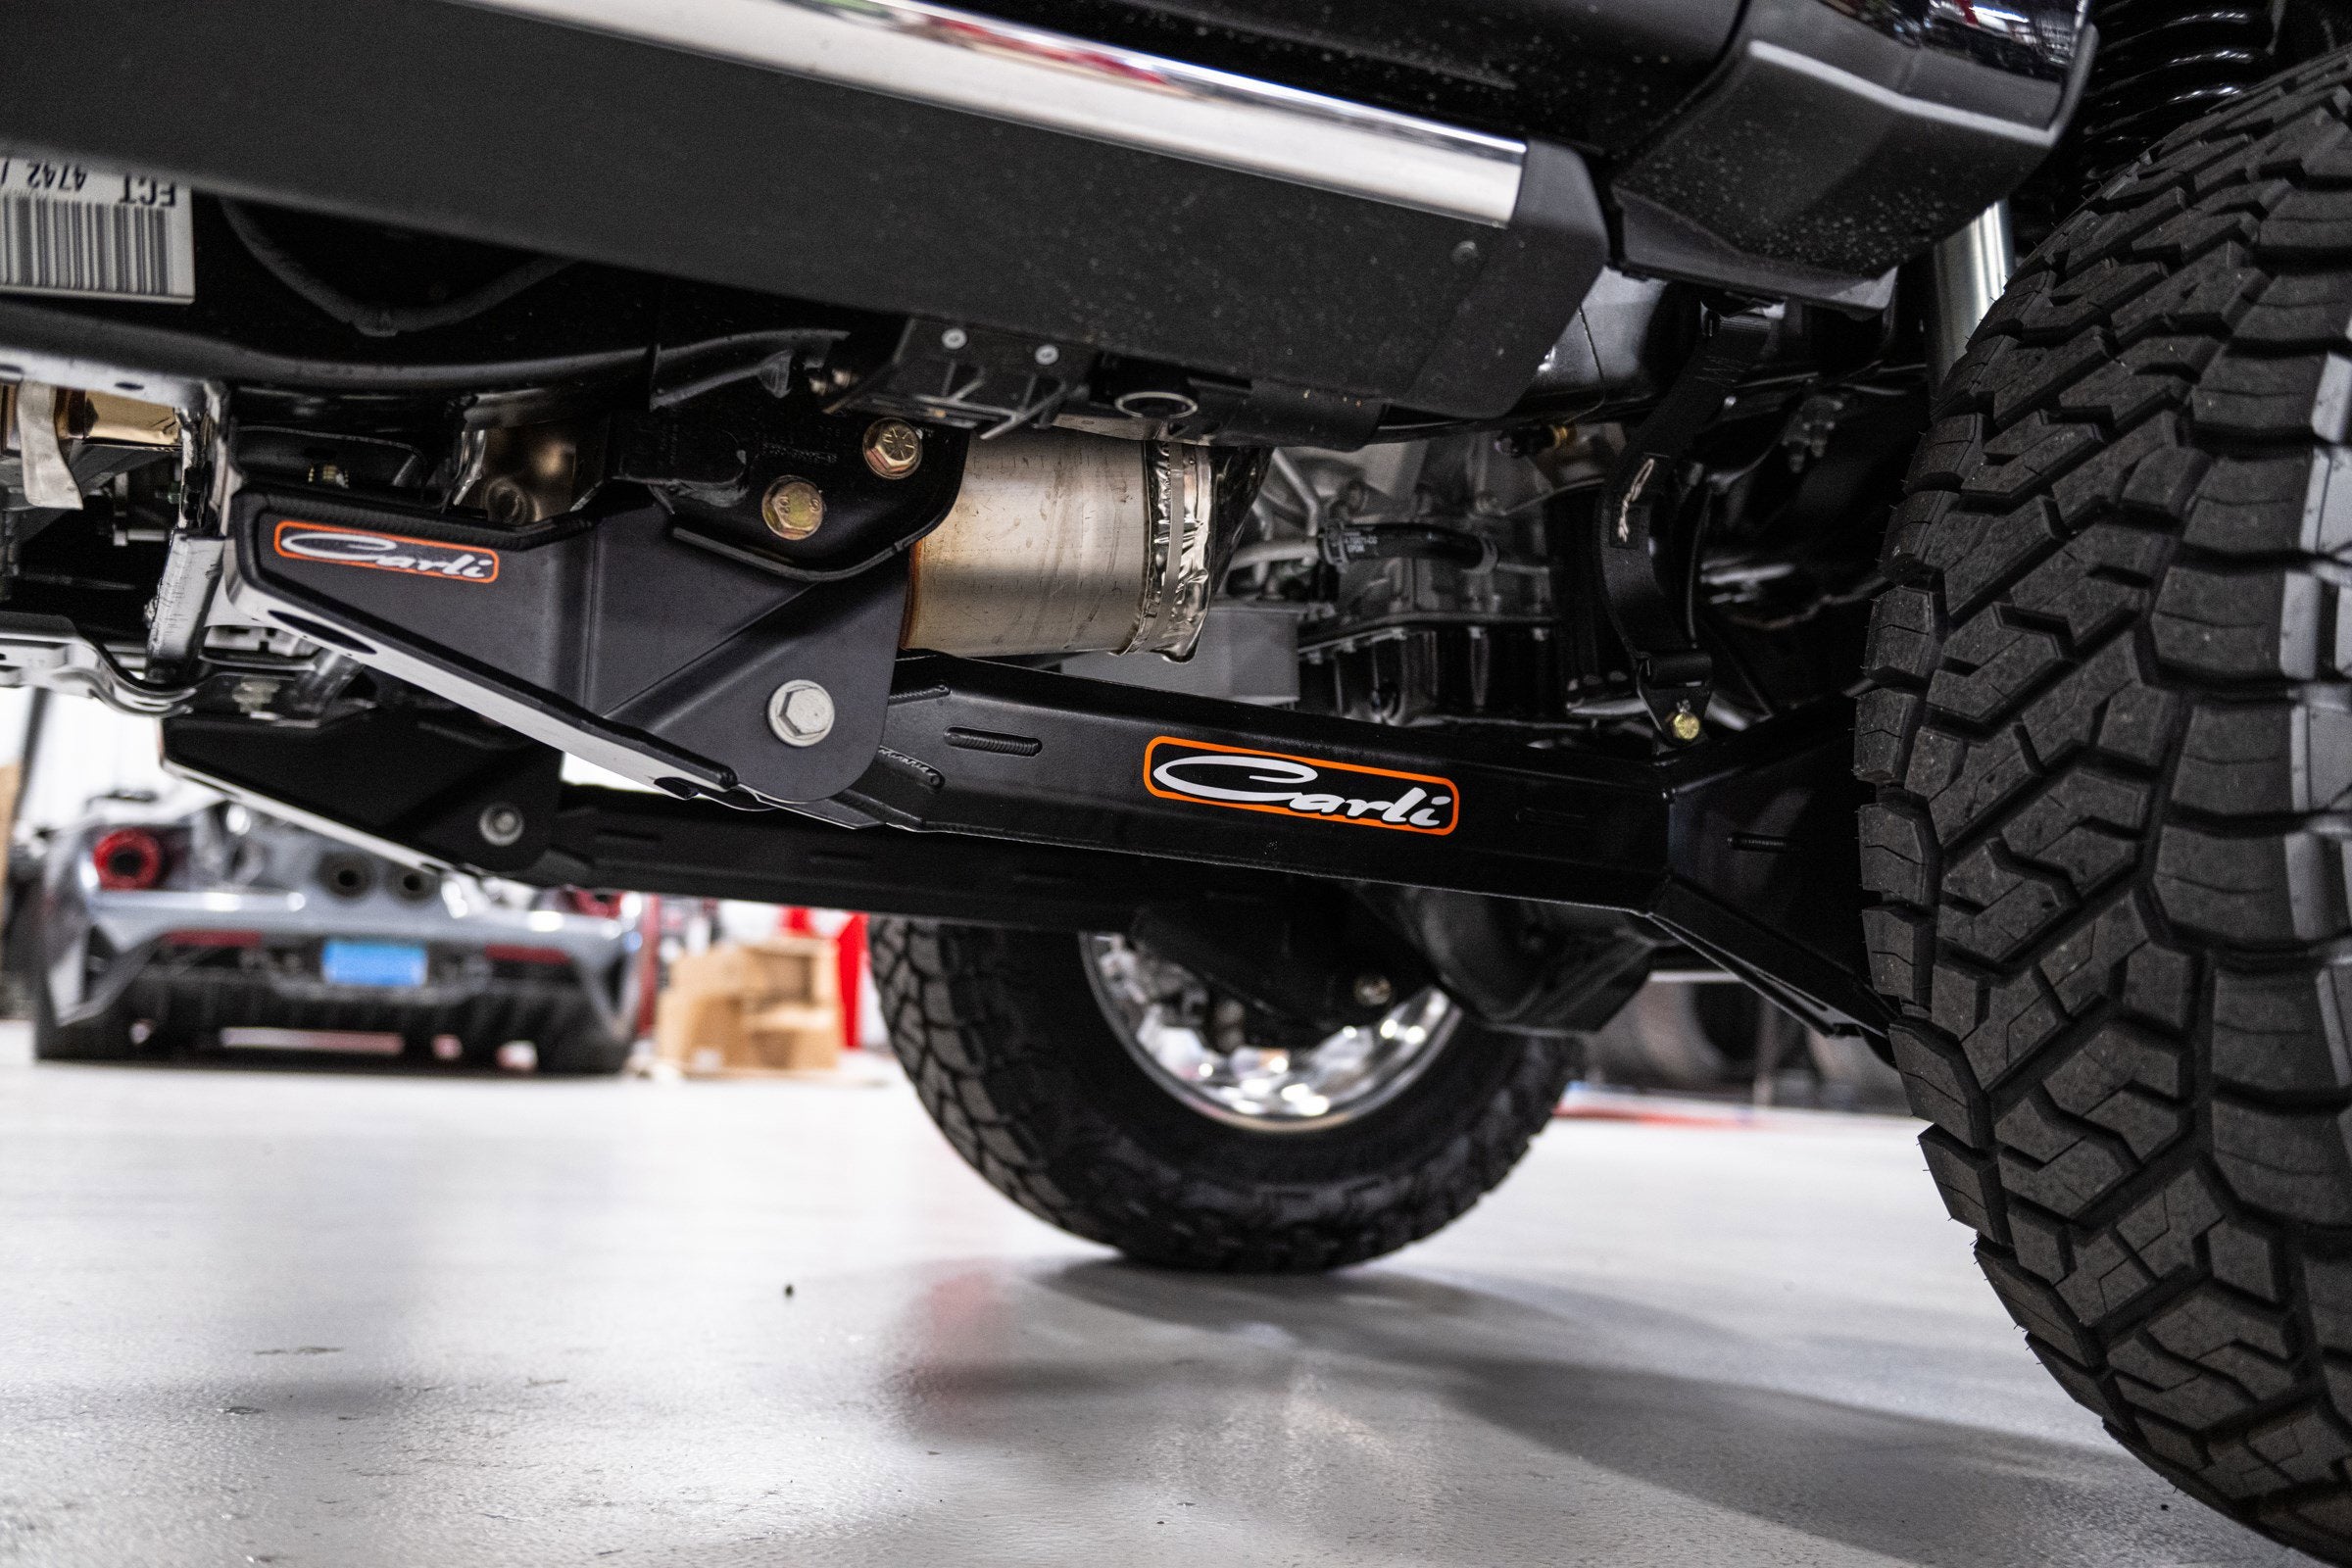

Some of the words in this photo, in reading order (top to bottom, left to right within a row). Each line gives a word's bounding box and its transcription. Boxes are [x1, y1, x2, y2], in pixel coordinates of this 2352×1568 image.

[27, 163, 88, 192] 4742
[280, 531, 494, 578] Carli
[1152, 755, 1452, 827] Carli
